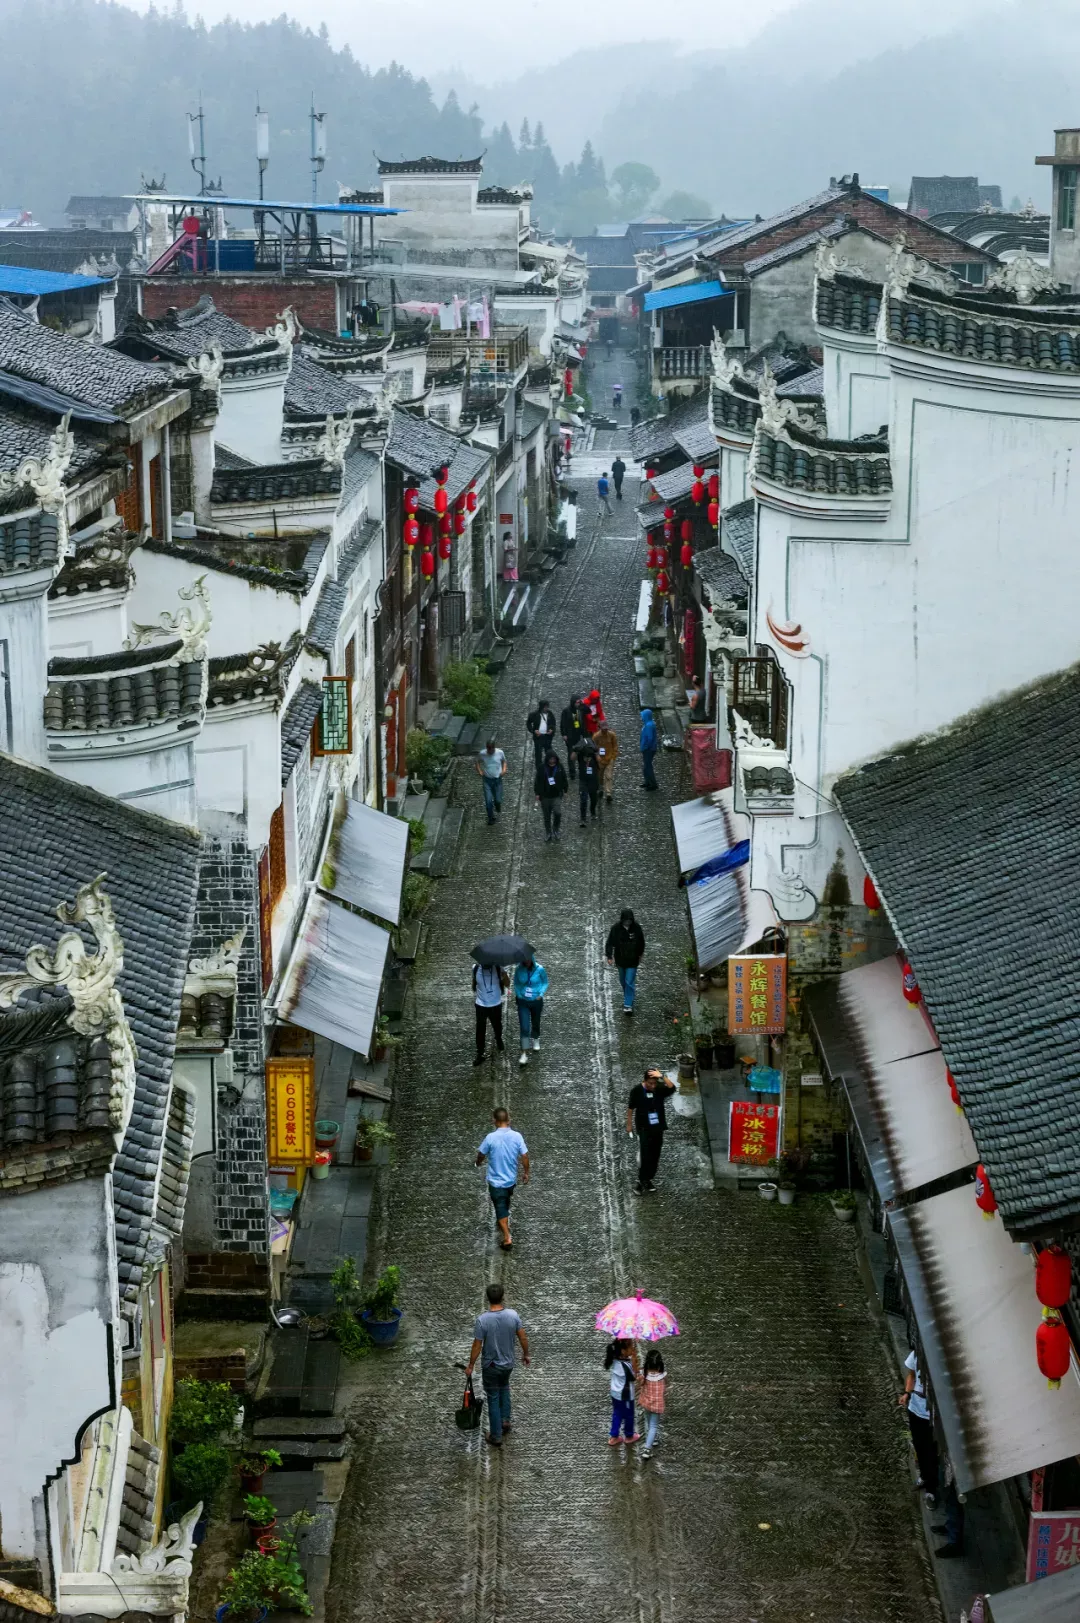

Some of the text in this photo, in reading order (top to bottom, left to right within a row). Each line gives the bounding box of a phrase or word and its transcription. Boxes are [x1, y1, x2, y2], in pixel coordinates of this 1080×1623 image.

[749, 961, 768, 1025] 永辉餐馆
[284, 1083, 297, 1146] 668餐饮
[742, 1118, 767, 1155] 冰凉粉
